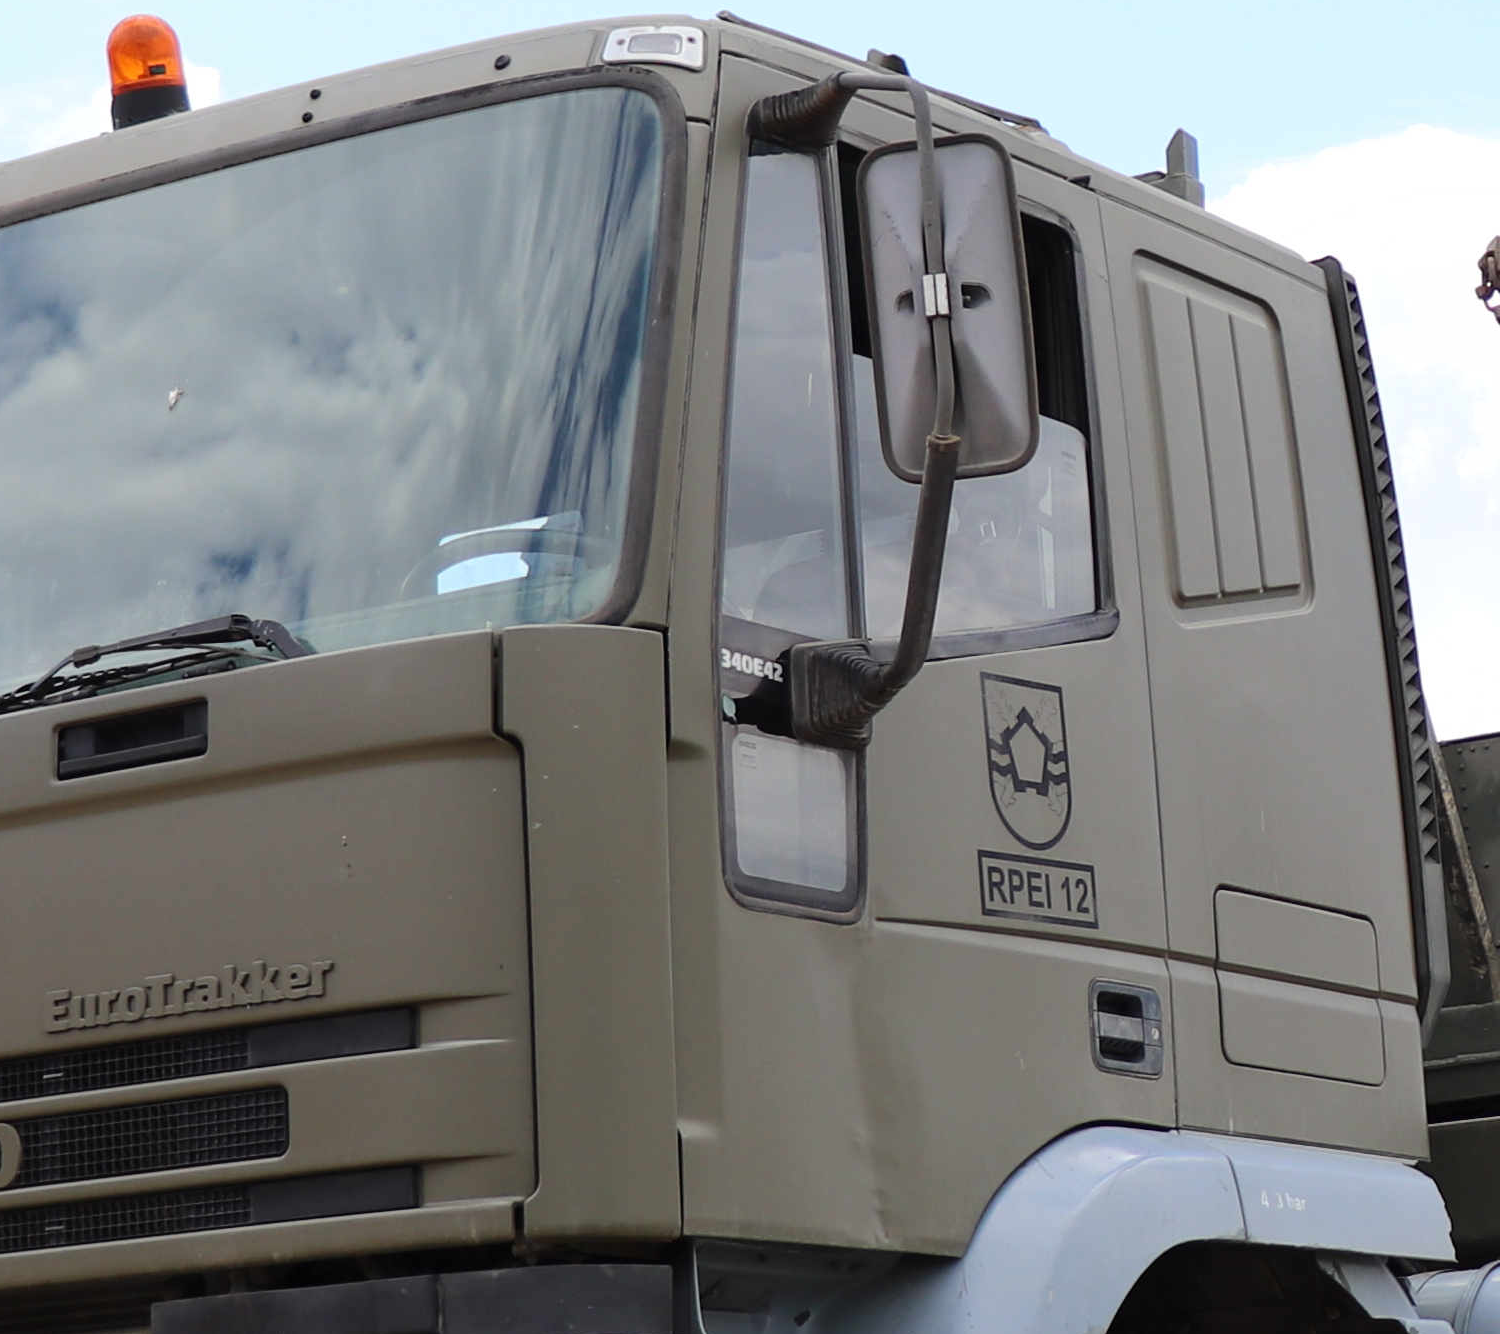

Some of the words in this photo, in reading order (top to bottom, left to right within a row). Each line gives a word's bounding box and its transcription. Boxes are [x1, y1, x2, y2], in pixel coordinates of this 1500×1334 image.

[720, 648, 784, 683] 340E42
[987, 865, 1052, 910] RPEI
[1061, 875, 1090, 914] 12
[46, 960, 335, 1034] EuroTrakker
[1285, 1192, 1306, 1211] bar
